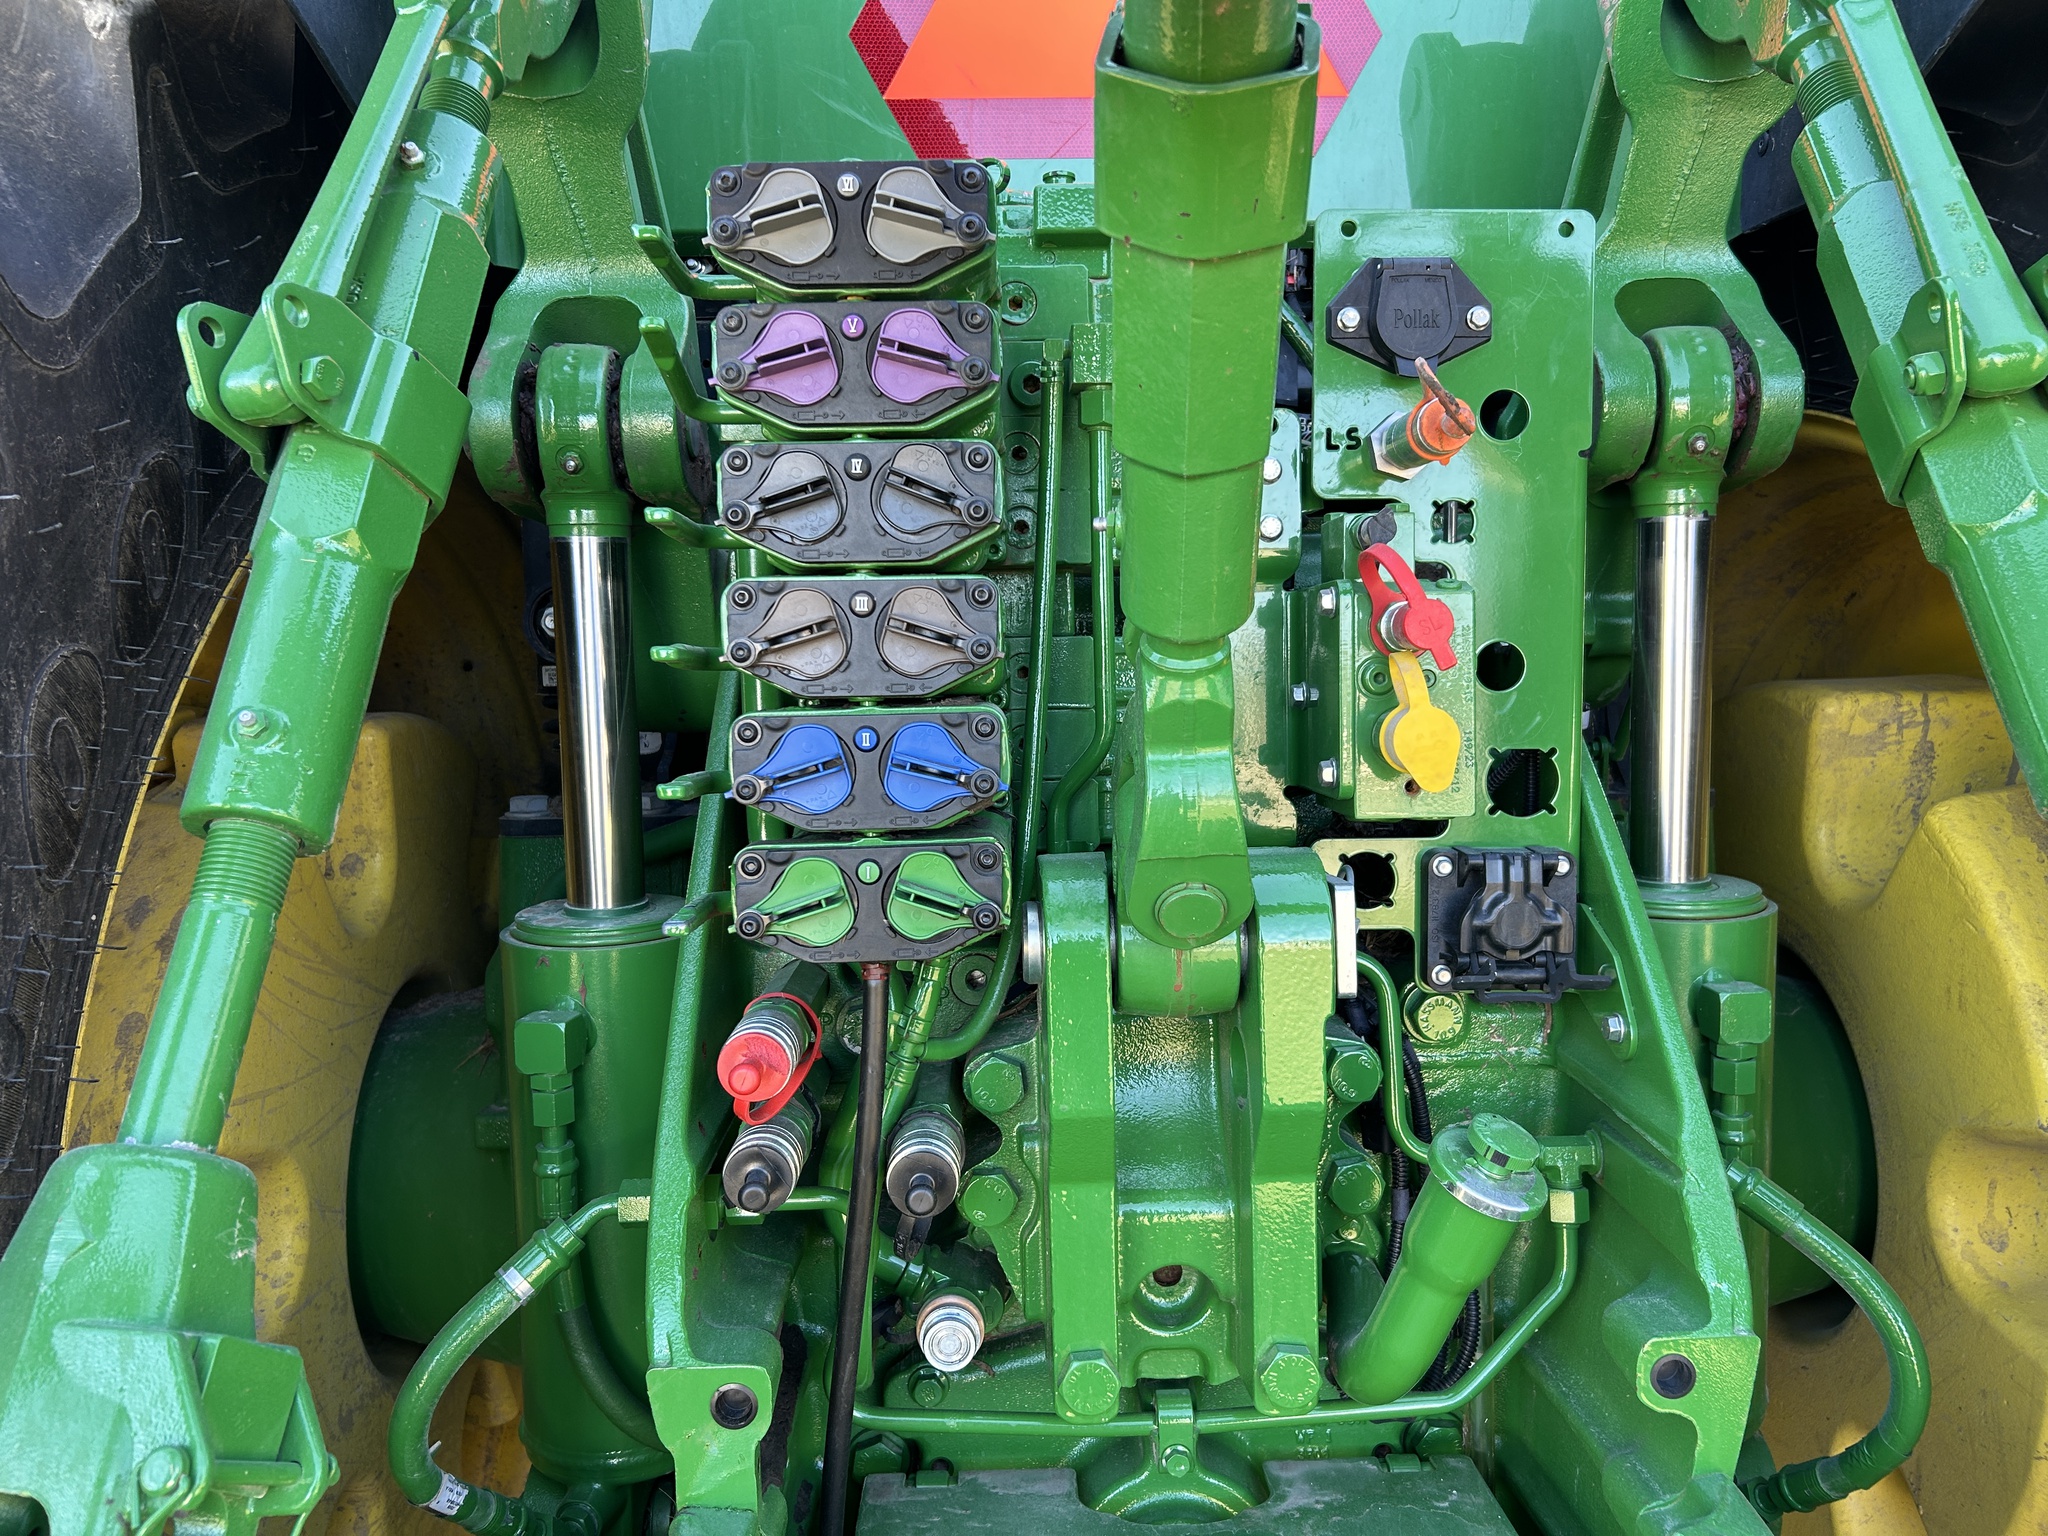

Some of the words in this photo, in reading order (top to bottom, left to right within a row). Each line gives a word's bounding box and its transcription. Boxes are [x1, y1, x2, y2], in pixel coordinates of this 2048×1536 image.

[841, 176, 854, 192] VI
[847, 317, 859, 333] V
[1393, 308, 1440, 329] Pollak
[851, 458, 863, 474] IV
[854, 596, 869, 612] III
[1418, 615, 1444, 636] SL
[861, 732, 871, 747] II
[865, 866, 871, 880] I
